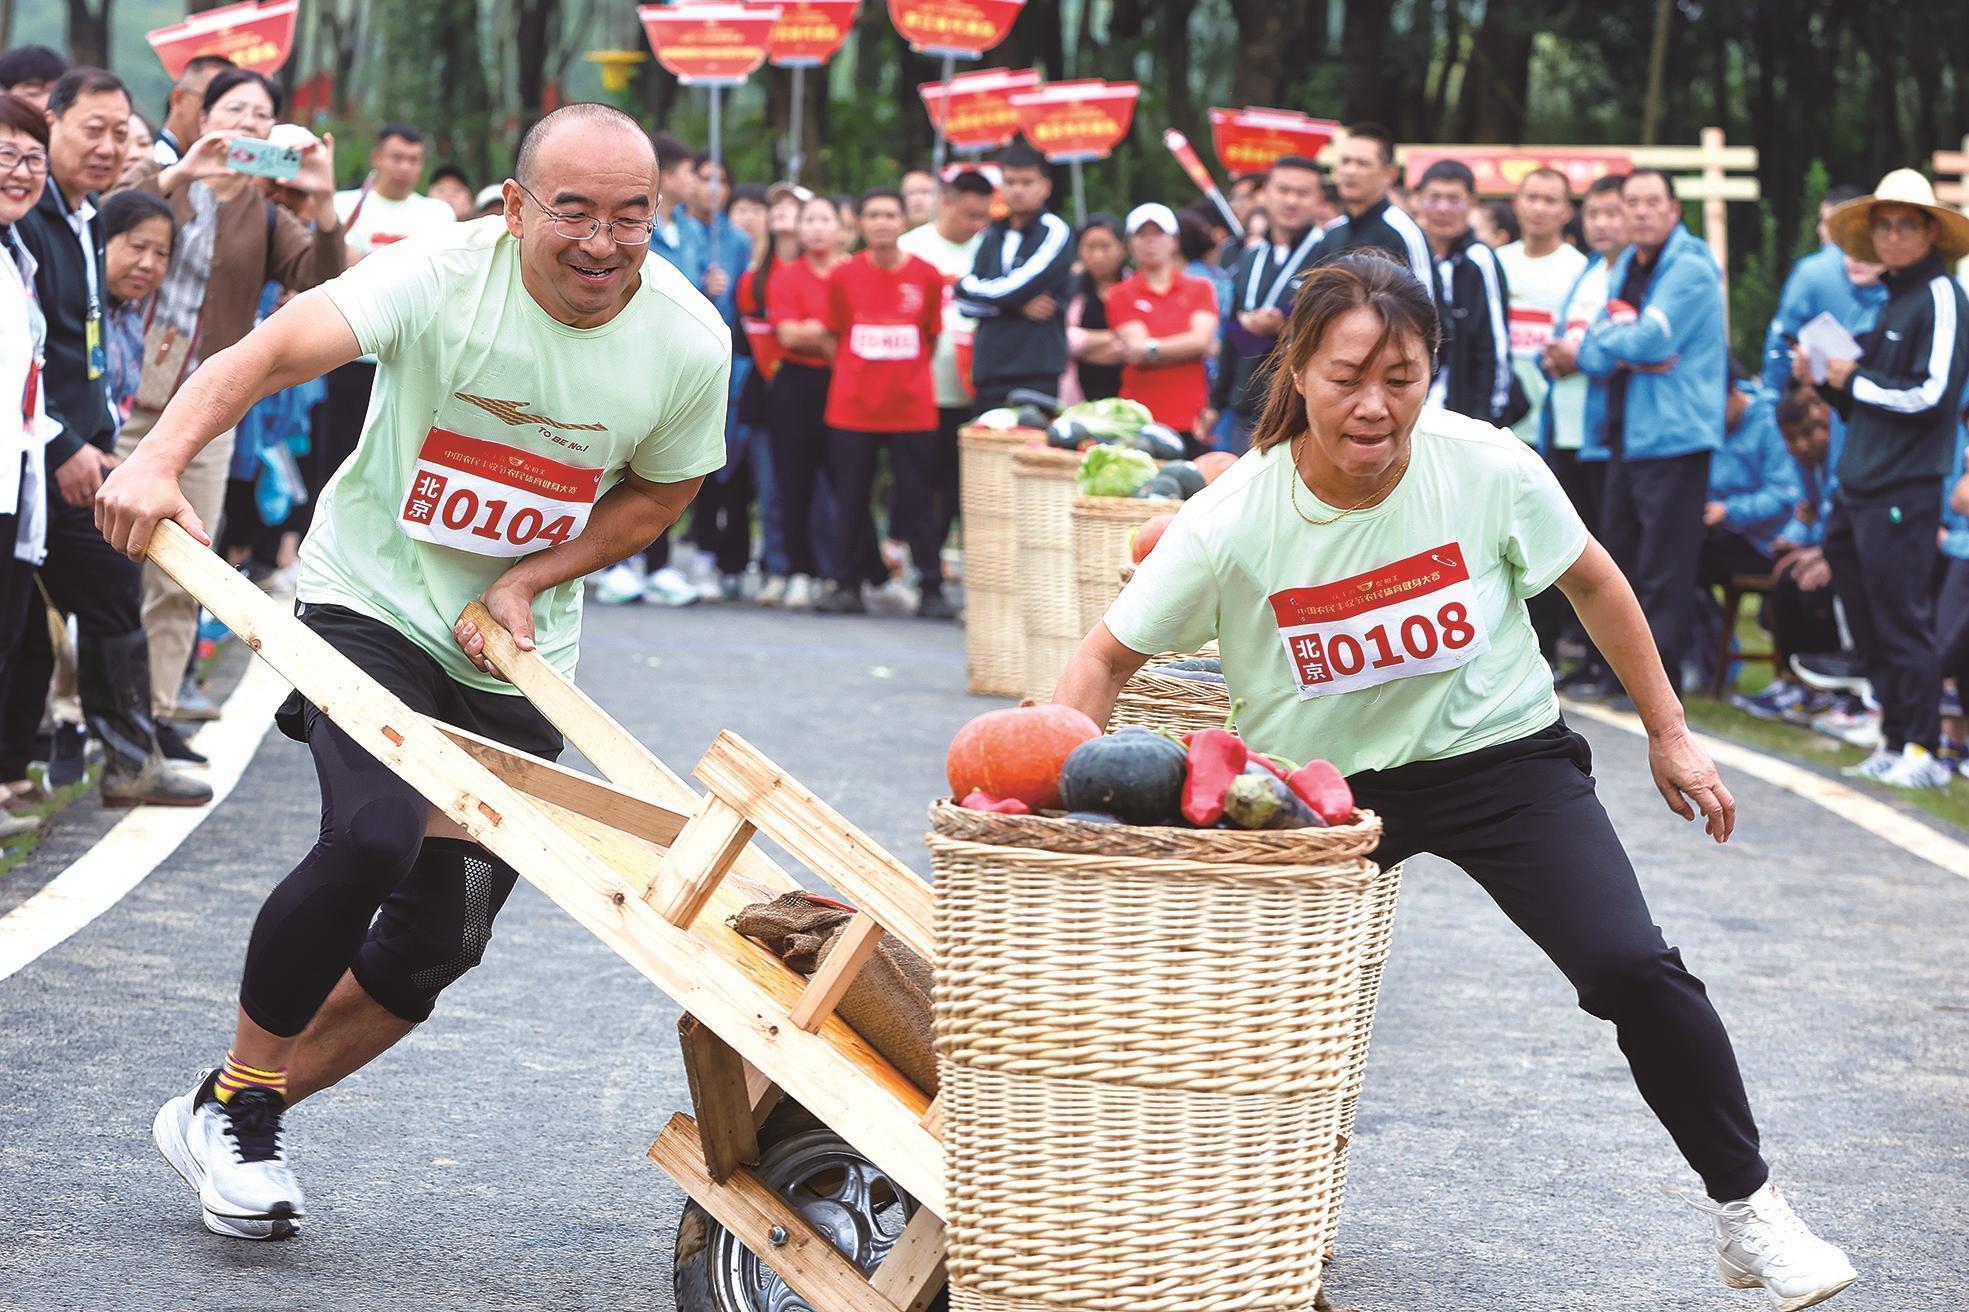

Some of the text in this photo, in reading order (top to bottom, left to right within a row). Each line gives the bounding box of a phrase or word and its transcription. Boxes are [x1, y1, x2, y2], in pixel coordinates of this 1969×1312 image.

[538, 426, 551, 438] TO
[551, 435, 569, 446] BE
[408, 476, 440, 520] 北京
[441, 488, 576, 547] 0104
[1296, 638, 1327, 681] 北京
[1327, 601, 1475, 676] 0108
